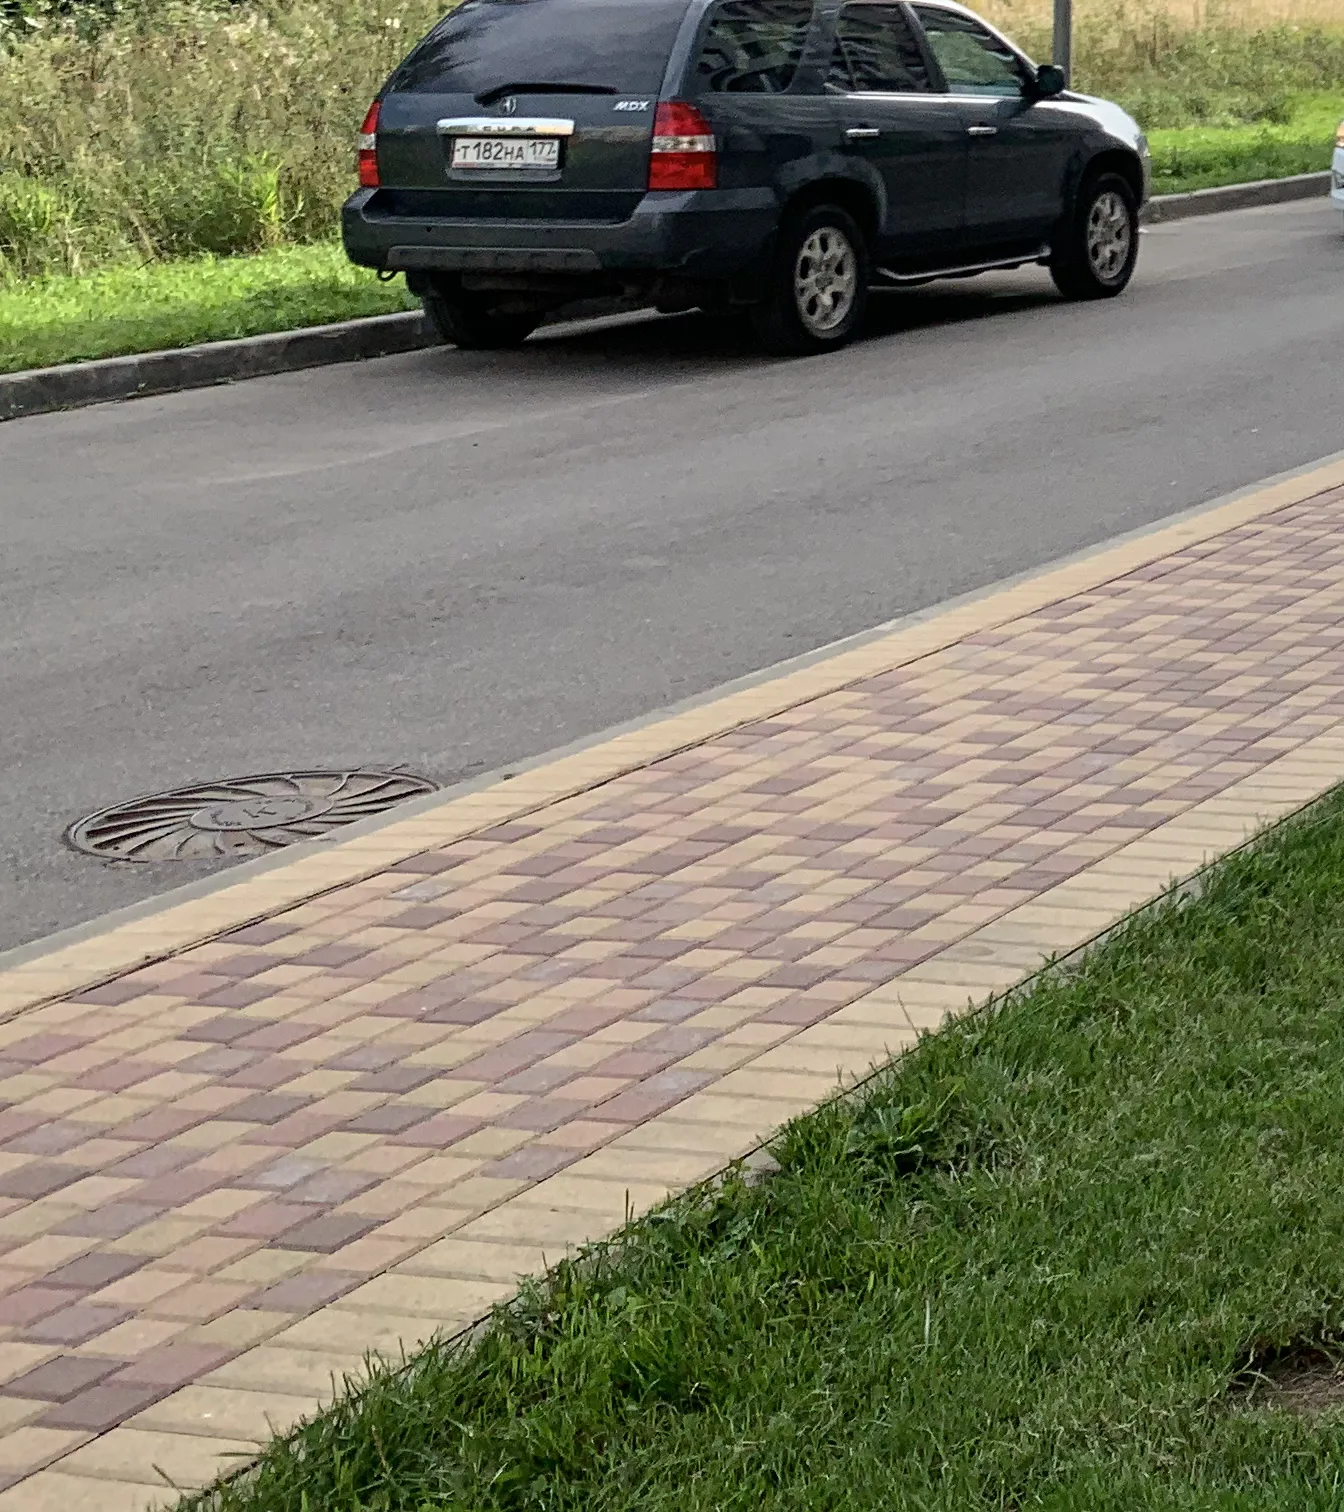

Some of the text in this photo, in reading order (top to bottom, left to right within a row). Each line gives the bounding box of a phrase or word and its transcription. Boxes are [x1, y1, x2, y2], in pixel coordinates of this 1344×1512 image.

[612, 100, 650, 112] MDX
[461, 140, 556, 160] Т182НА 177
